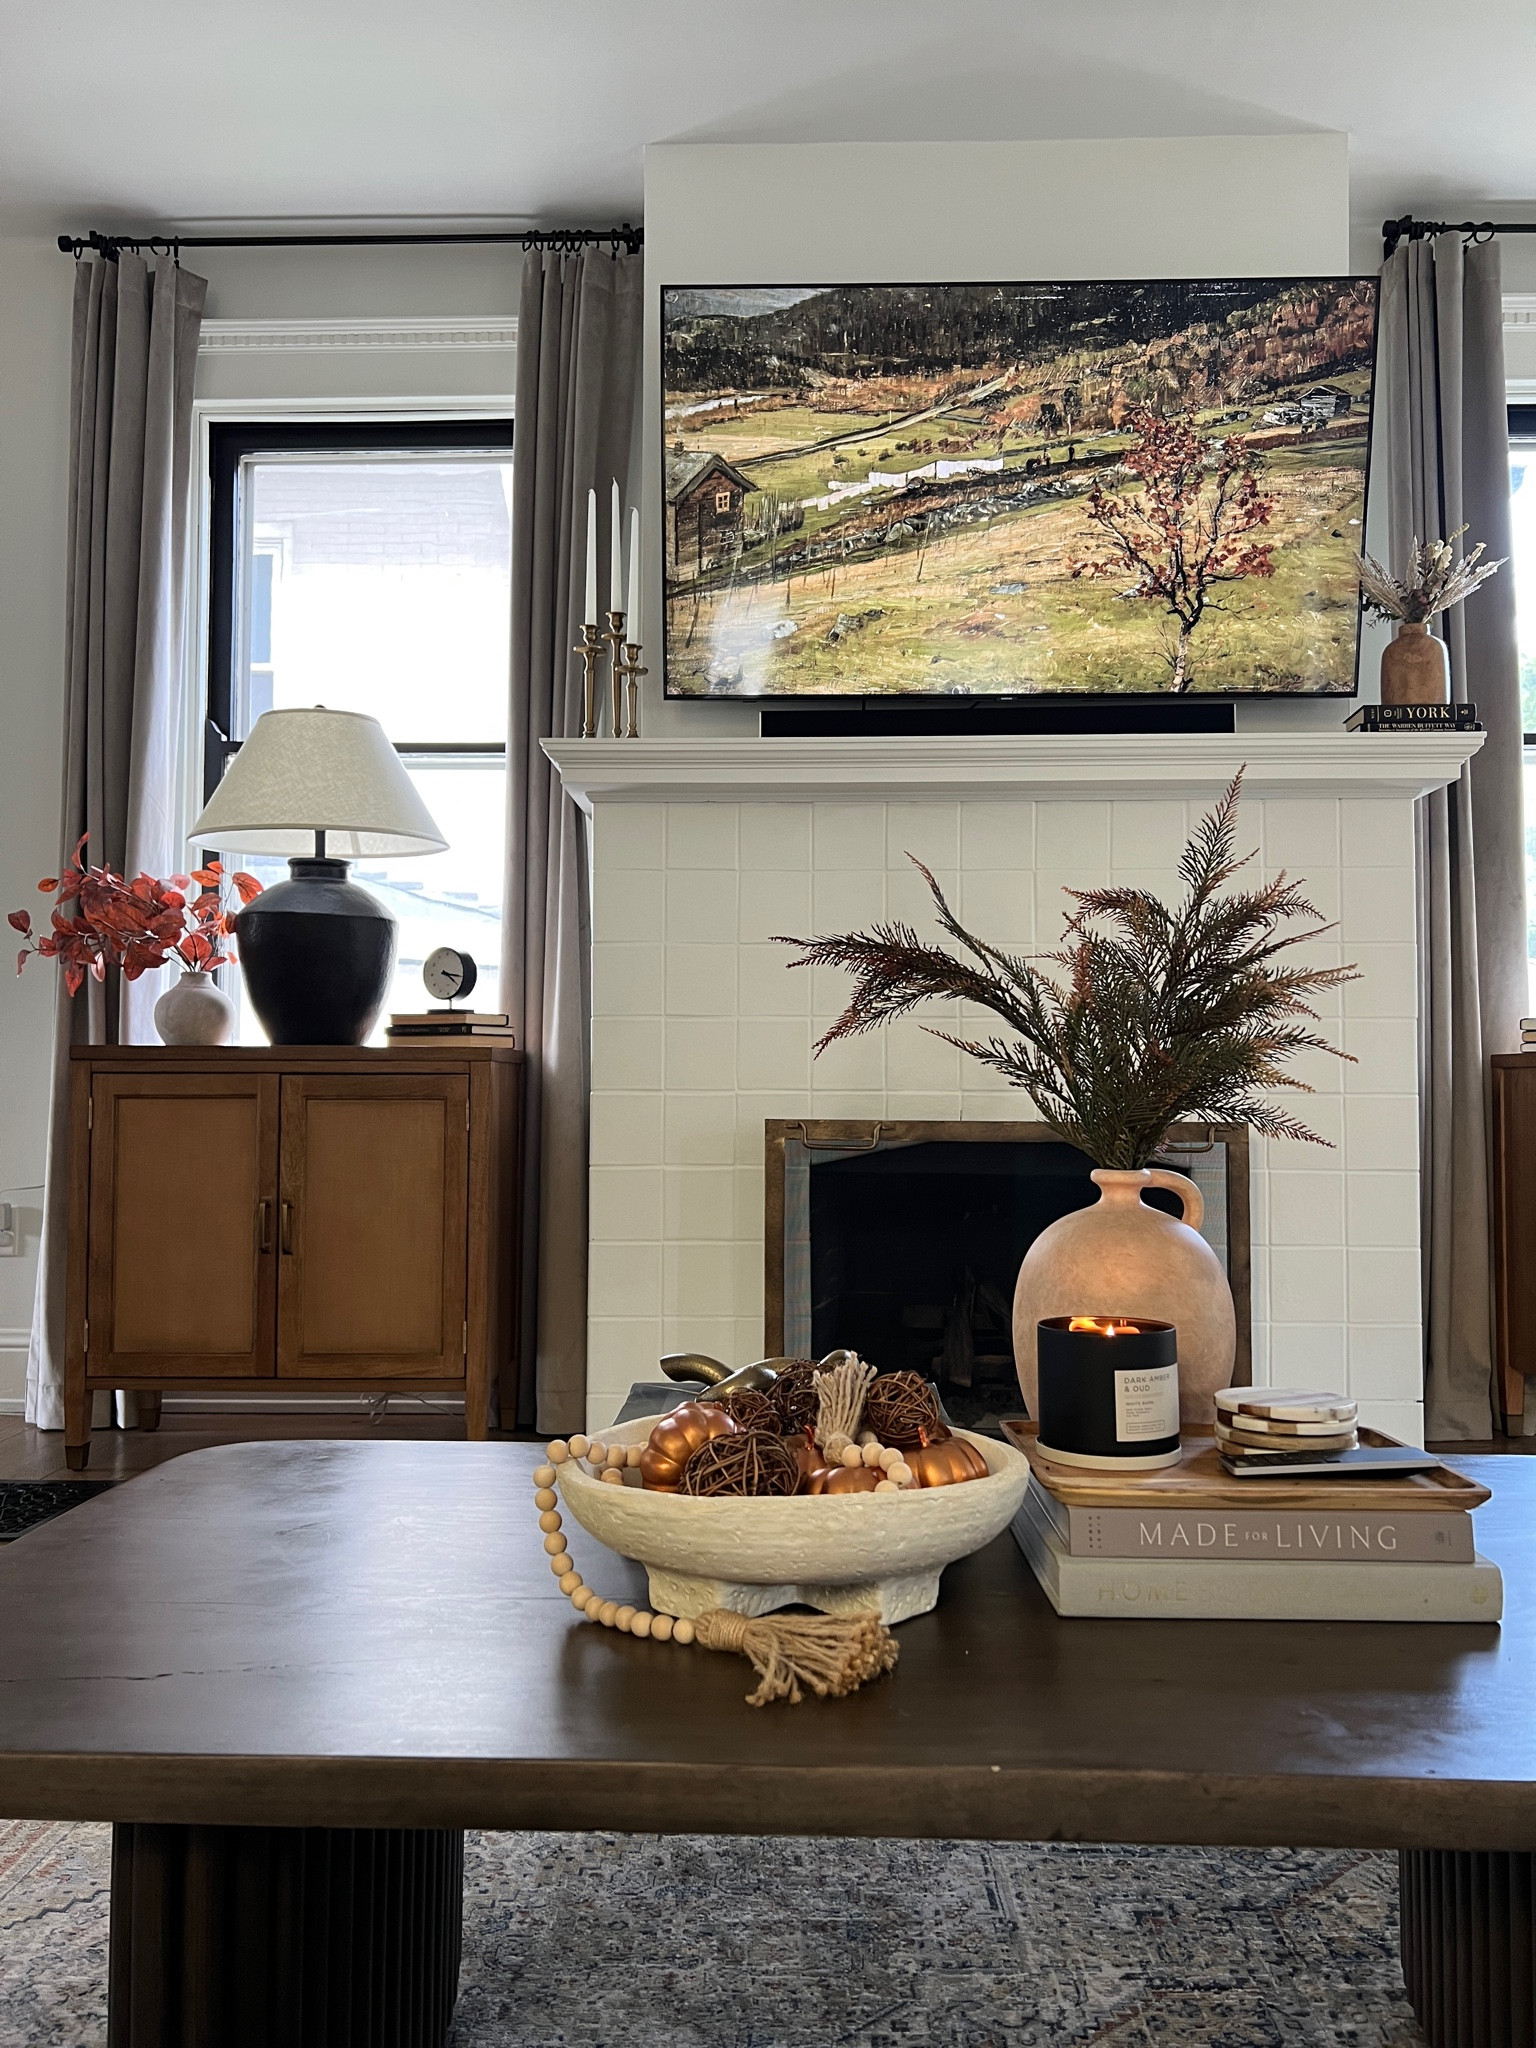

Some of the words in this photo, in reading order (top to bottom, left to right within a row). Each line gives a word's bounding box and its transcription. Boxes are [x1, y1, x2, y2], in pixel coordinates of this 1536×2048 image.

[1406, 706, 1451, 719] YORK
[1139, 1522, 1239, 1547] MADE
[1245, 1531, 1268, 1541] FOR
[1276, 1524, 1398, 1550] LIVING
